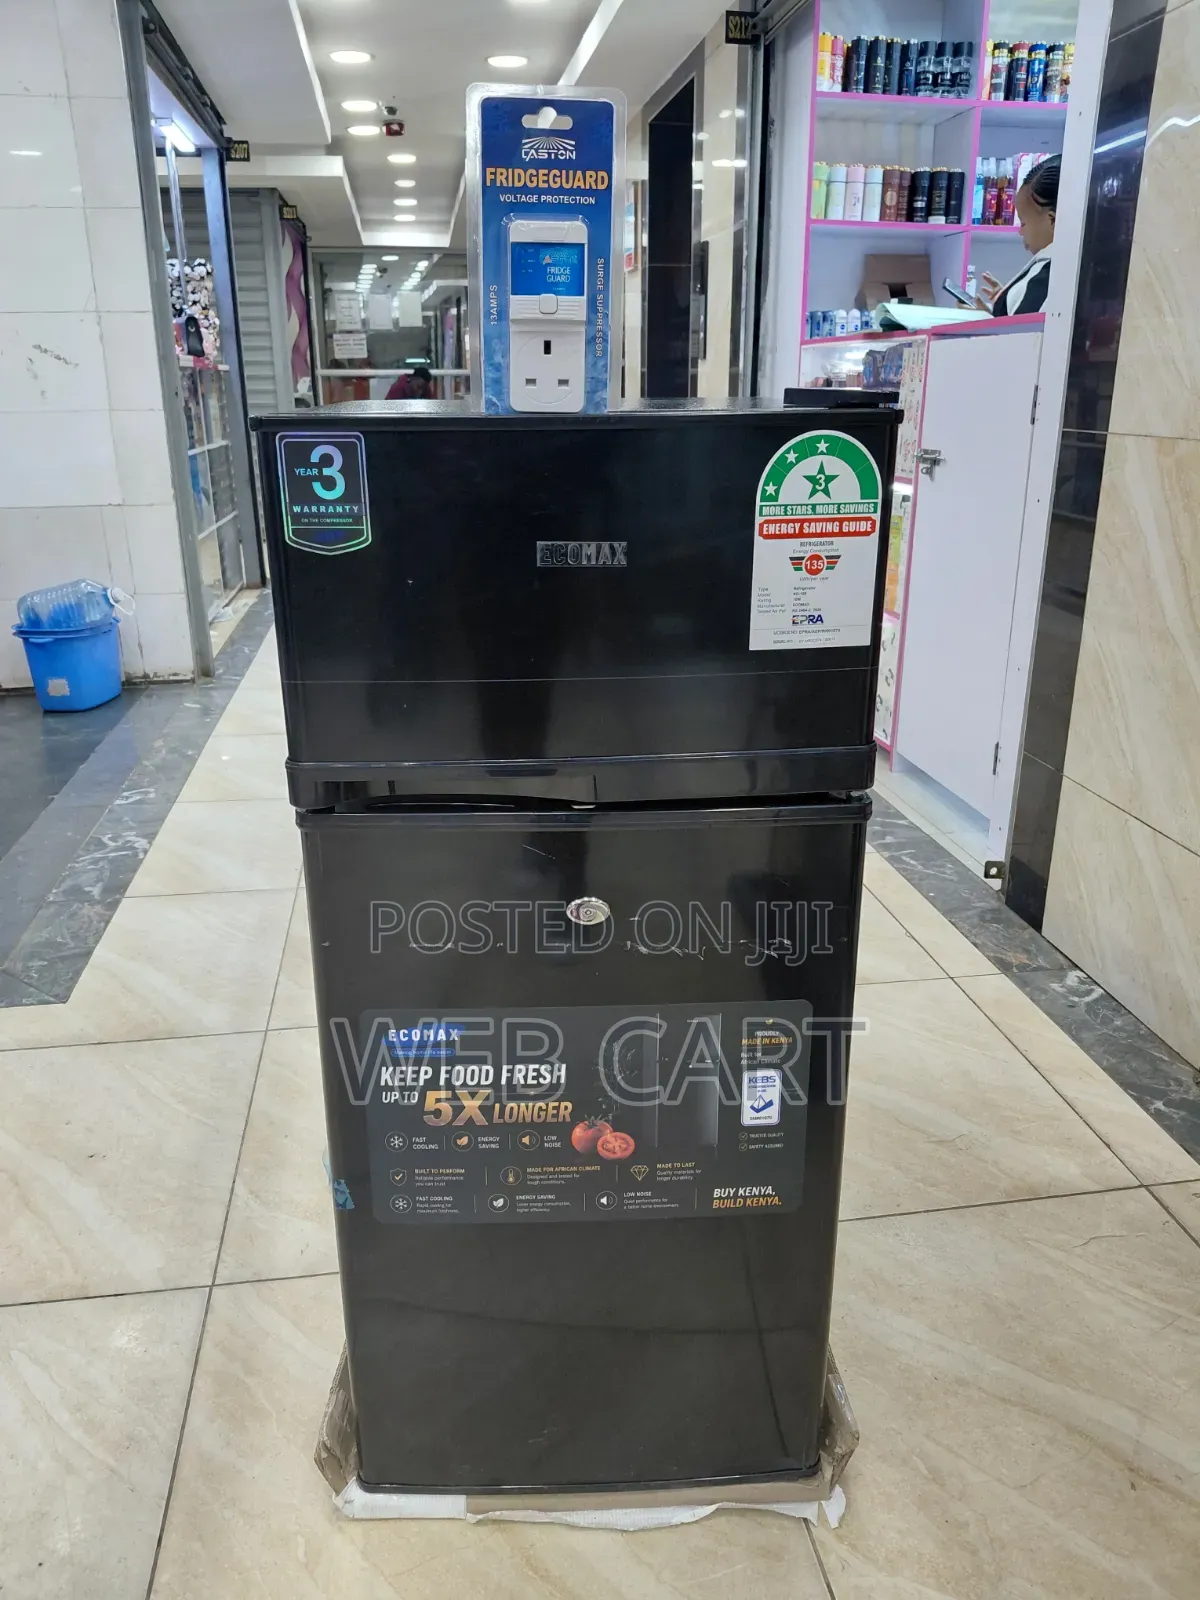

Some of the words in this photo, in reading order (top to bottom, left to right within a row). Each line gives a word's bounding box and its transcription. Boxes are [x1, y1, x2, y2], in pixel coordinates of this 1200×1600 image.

[486, 168, 608, 189] FRIDGEGUARD
[500, 194, 538, 203] VOLTAGE
[541, 195, 595, 204] PROTECTION
[596, 258, 604, 291] SURGE
[489, 285, 497, 326] 13AMPS
[595, 294, 604, 357] SUPPRESSOR
[294, 468, 318, 476] YEAR
[310, 444, 345, 500] 3
[816, 474, 826, 490] 3
[293, 505, 358, 513] WARRANTY
[763, 506, 784, 515] MORE
[787, 505, 813, 515] STARS,
[816, 504, 837, 514] MORE
[840, 503, 874, 513] SAVINGS
[763, 522, 800, 534] ENERGY
[803, 521, 839, 533] SAVING
[842, 520, 872, 532] GUIDE
[538, 542, 627, 565] ECOMAX
[806, 560, 823, 569] 135
[792, 614, 824, 625] EPRA
[388, 1028, 458, 1041] ECOMAX
[380, 1066, 432, 1086] KEEP
[439, 1065, 494, 1086] FOOD
[501, 1064, 566, 1085] FRESH
[382, 1092, 399, 1104] UP
[403, 1091, 419, 1103] TO
[423, 1089, 491, 1126] 5X
[493, 1101, 573, 1123] LONGER
[713, 1188, 736, 1198] BUY
[738, 1186, 775, 1196] KENYA,
[712, 1198, 743, 1208] BUILD
[746, 1196, 782, 1207] KENYA.
